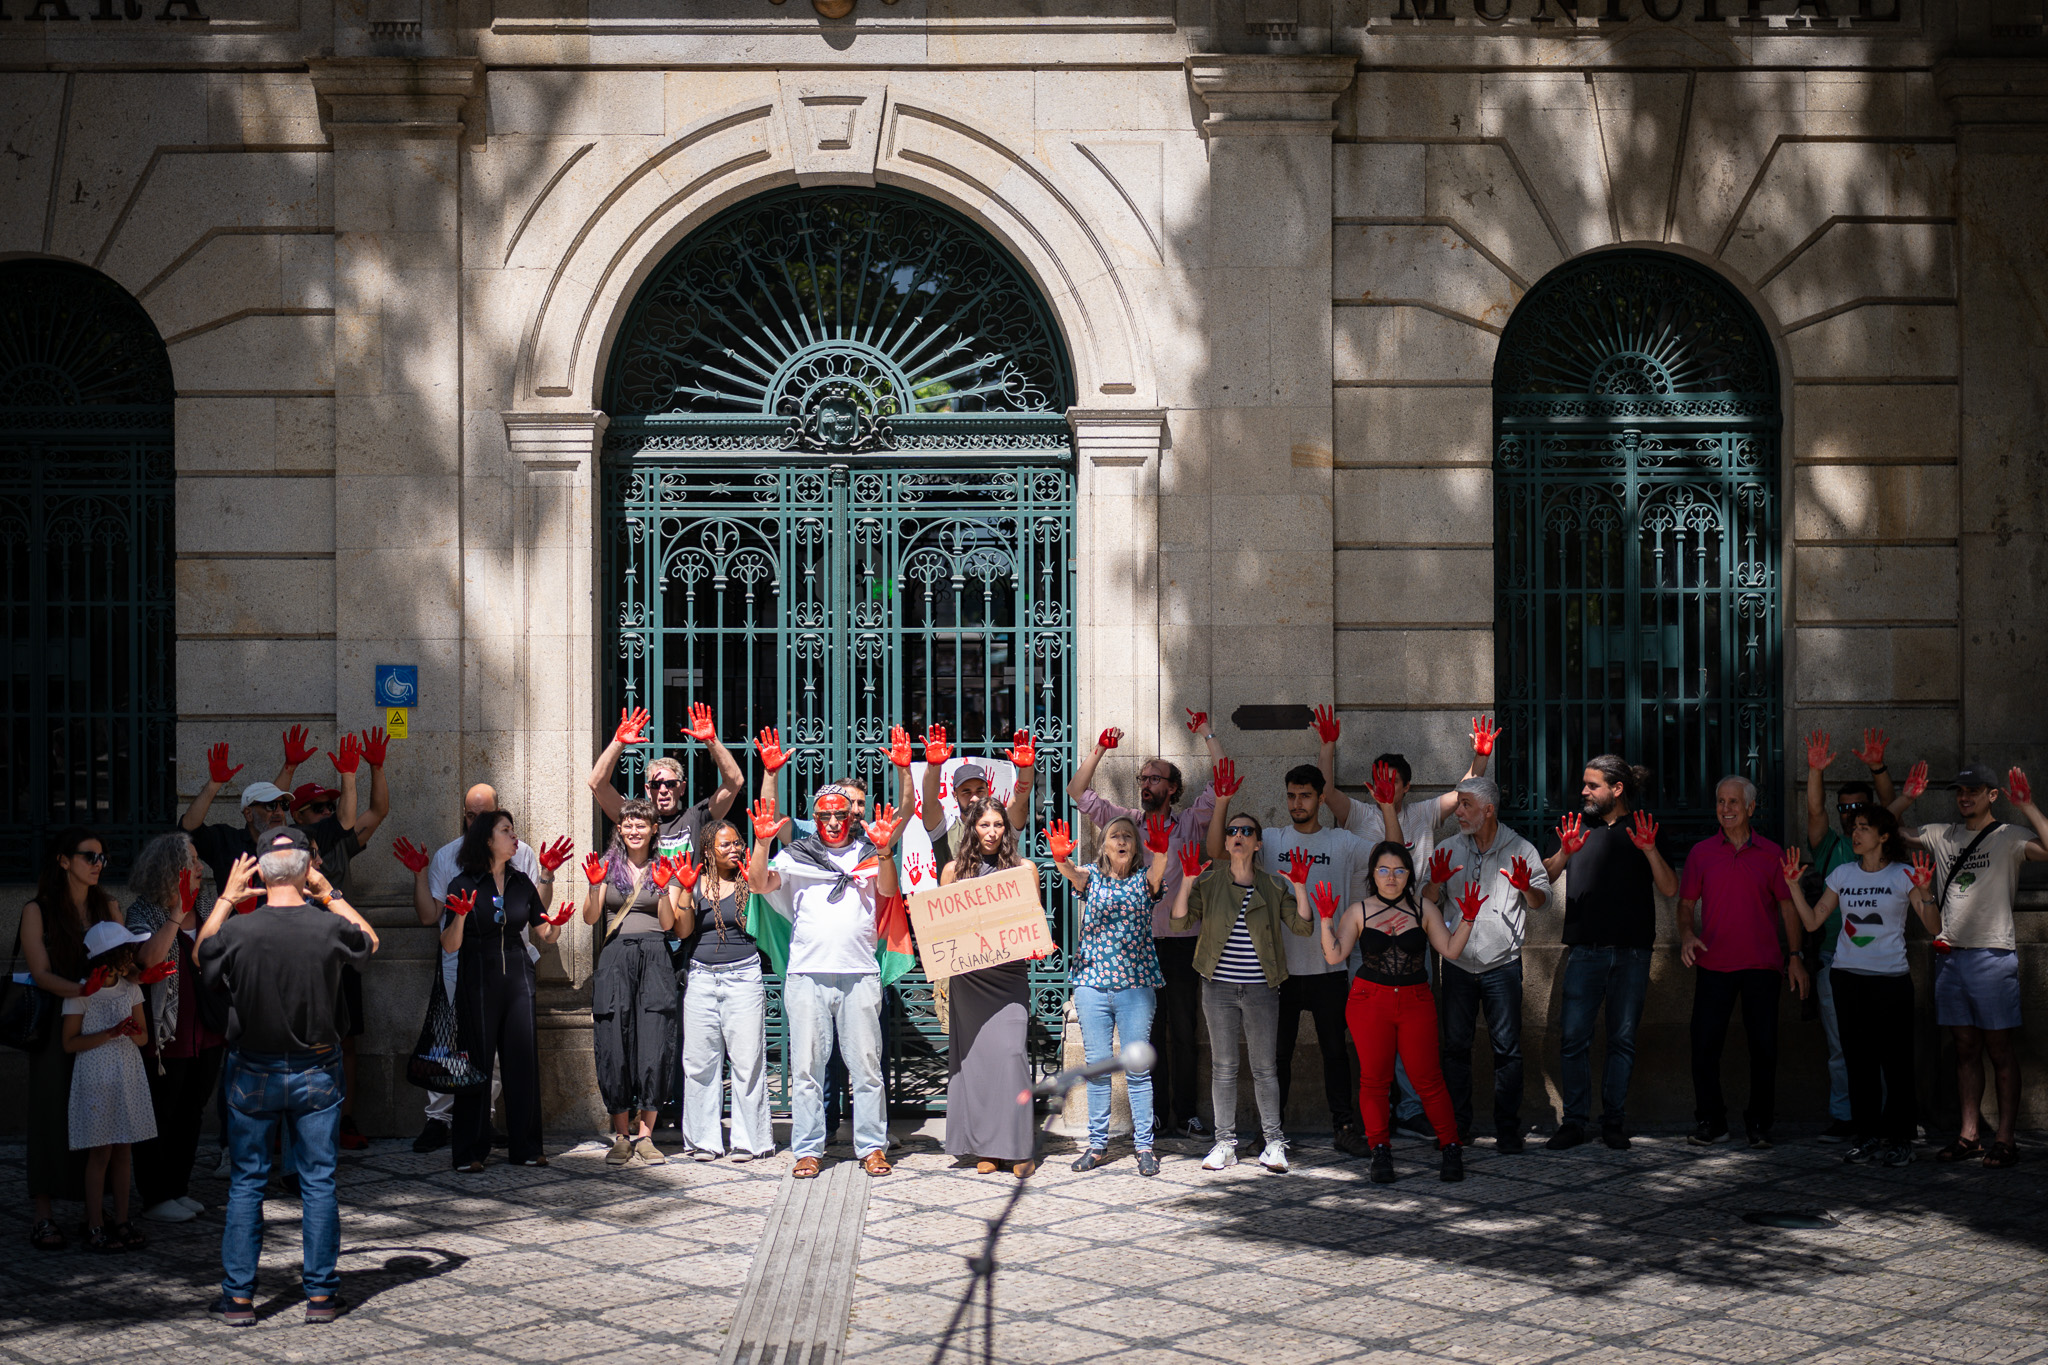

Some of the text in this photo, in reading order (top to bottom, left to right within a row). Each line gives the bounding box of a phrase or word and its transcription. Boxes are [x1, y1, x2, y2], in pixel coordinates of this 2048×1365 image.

[927, 879, 1021, 921] MORRERAM
[1839, 887, 1892, 896] PALESTINA
[1847, 899, 1878, 908] LIVRE
[931, 939, 958, 963] 57
[974, 923, 1041, 954] À FOME
[950, 947, 1011, 973] CRIANÇAS
